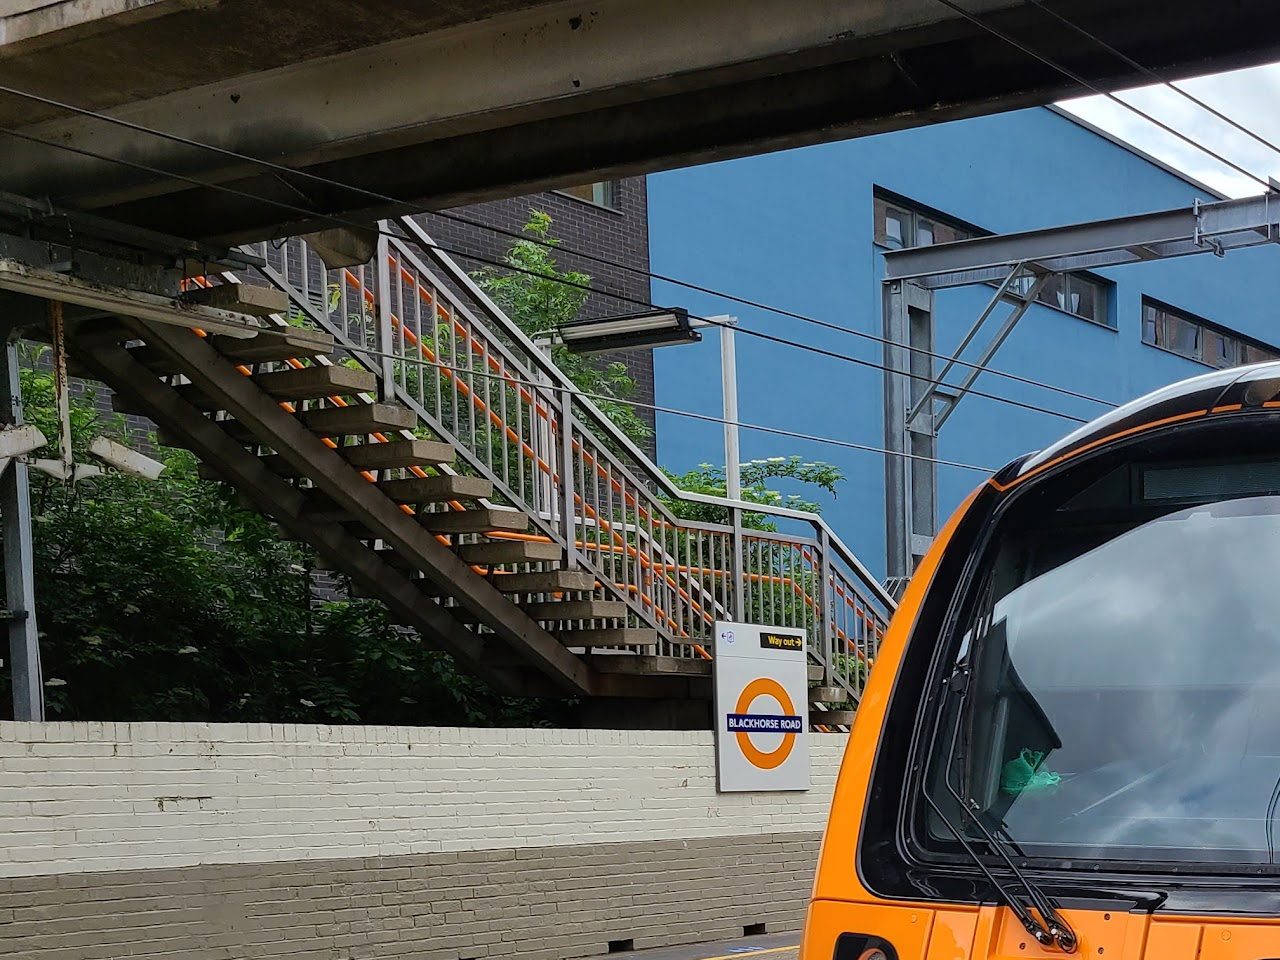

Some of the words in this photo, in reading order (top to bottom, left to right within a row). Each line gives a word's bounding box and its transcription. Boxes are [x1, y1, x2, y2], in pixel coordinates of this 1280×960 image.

[768, 635, 782, 647] Way
[783, 638, 796, 647] out
[728, 718, 779, 729] BLACKHORSE
[780, 719, 801, 730] ROAD
